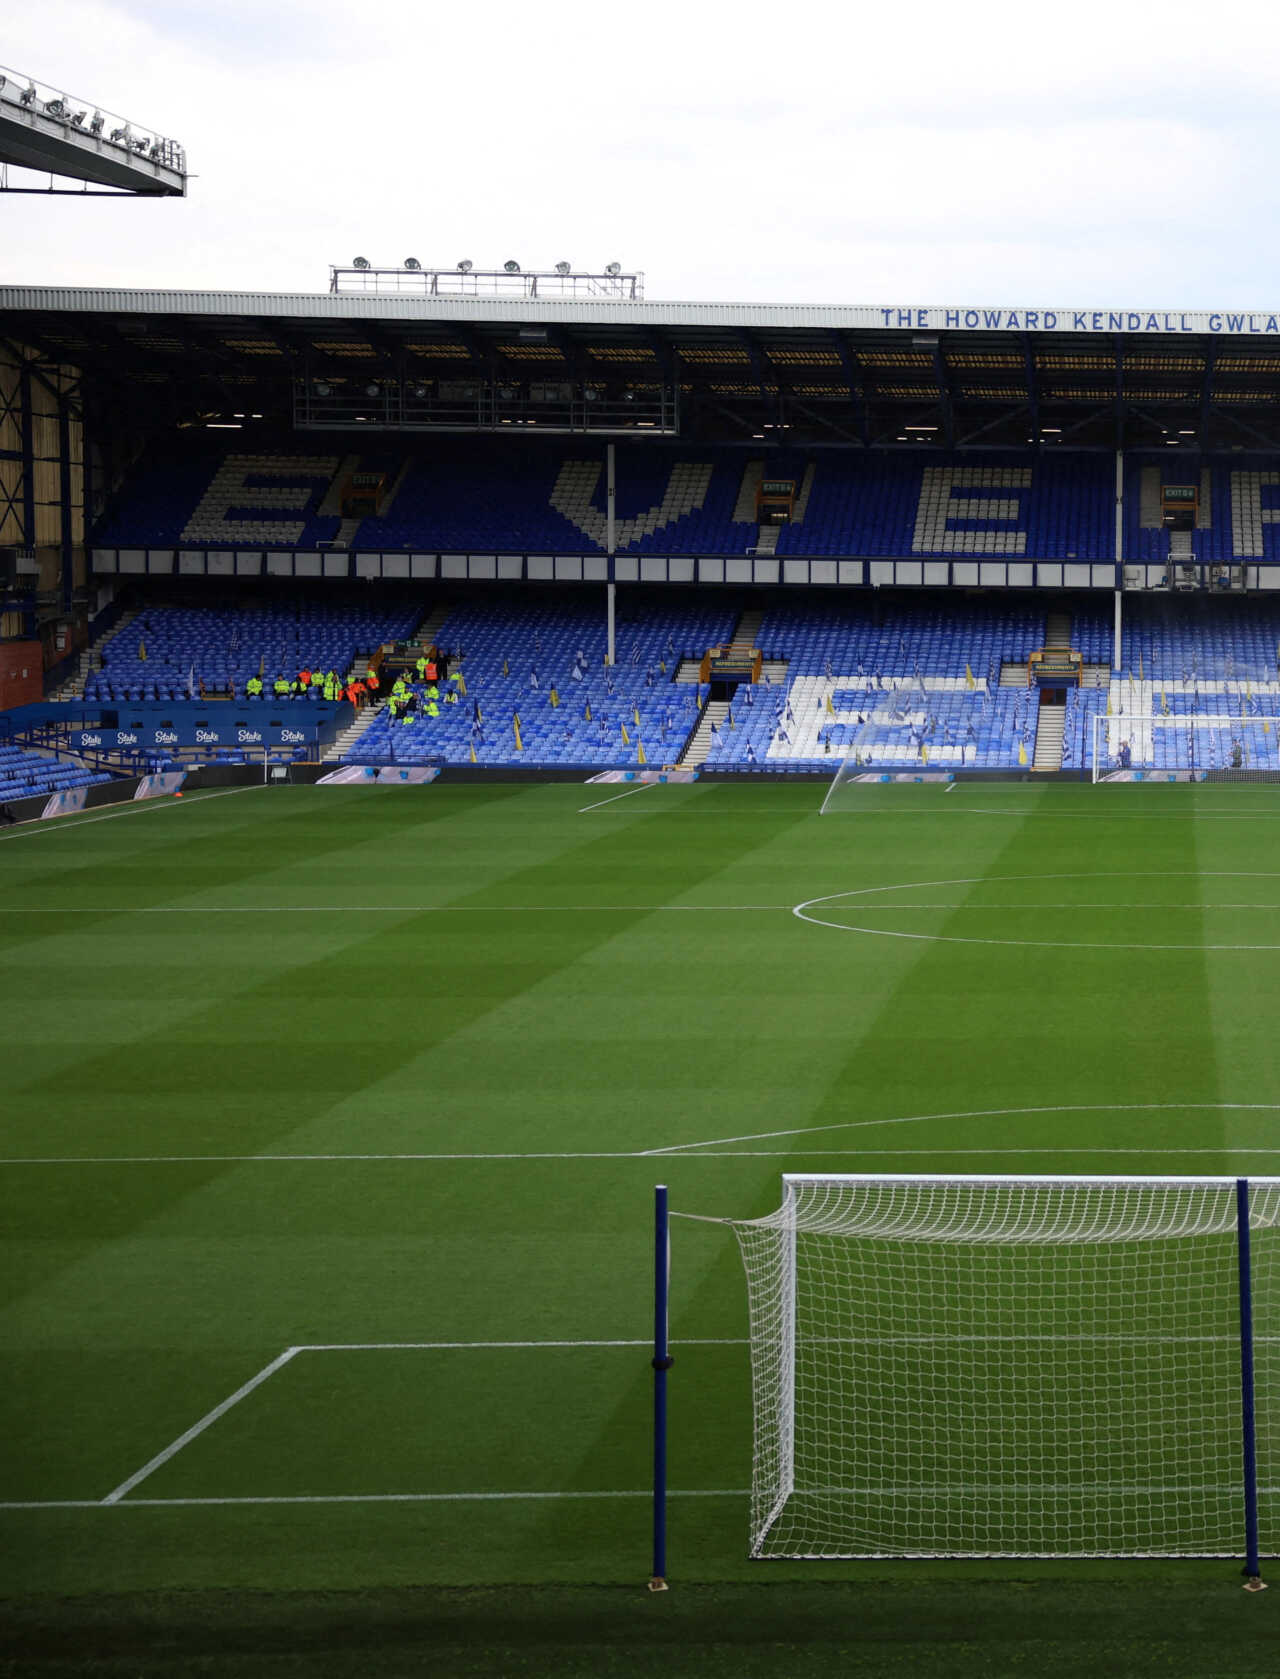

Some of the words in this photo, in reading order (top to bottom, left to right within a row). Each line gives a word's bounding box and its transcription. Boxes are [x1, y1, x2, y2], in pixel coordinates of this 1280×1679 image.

[880, 308, 929, 328] THE
[945, 309, 1058, 330] HOWARD
[1073, 311, 1193, 332] KENDALL
[81, 733, 102, 745] Stake
[117, 732, 137, 744] Stake
[155, 730, 178, 743] Stake
[196, 730, 219, 743] Stake
[238, 729, 262, 742] Stake
[281, 729, 305, 742] Stake
